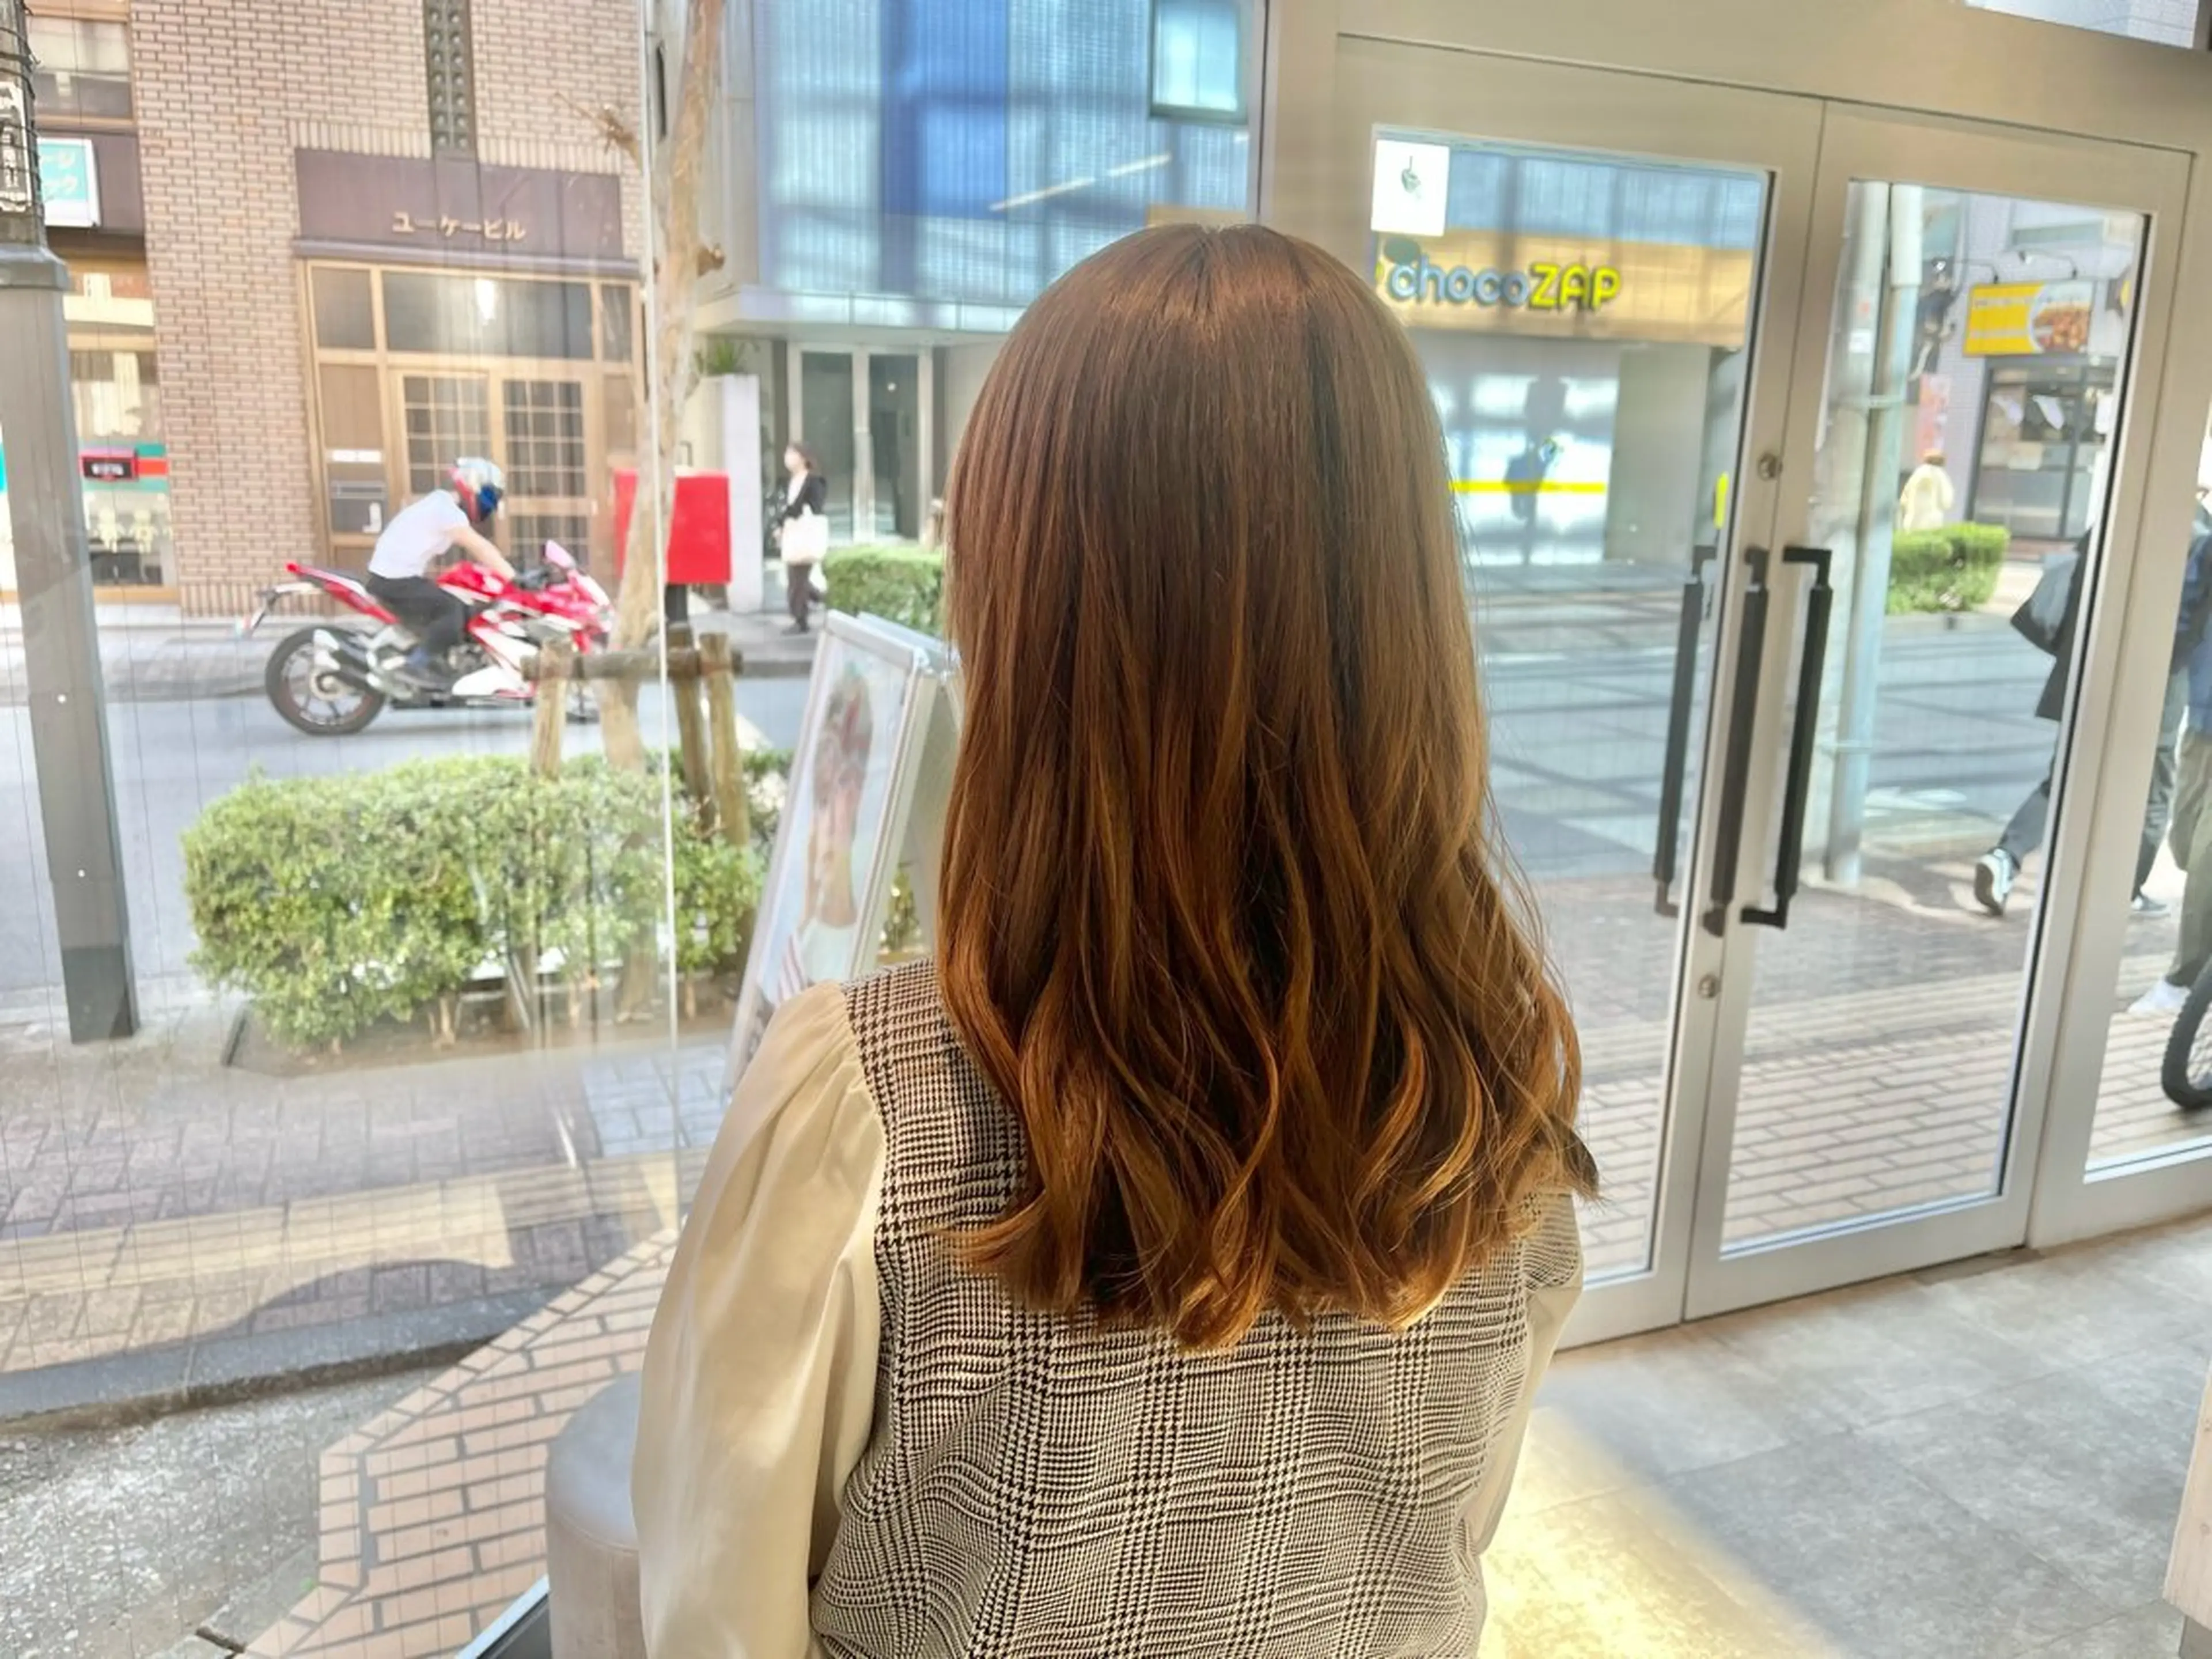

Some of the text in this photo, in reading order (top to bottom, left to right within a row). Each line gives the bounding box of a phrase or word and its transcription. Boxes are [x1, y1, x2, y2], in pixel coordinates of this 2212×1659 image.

[392, 211, 527, 240] ユーケービル
[1391, 254, 1622, 309] chocoZAP
